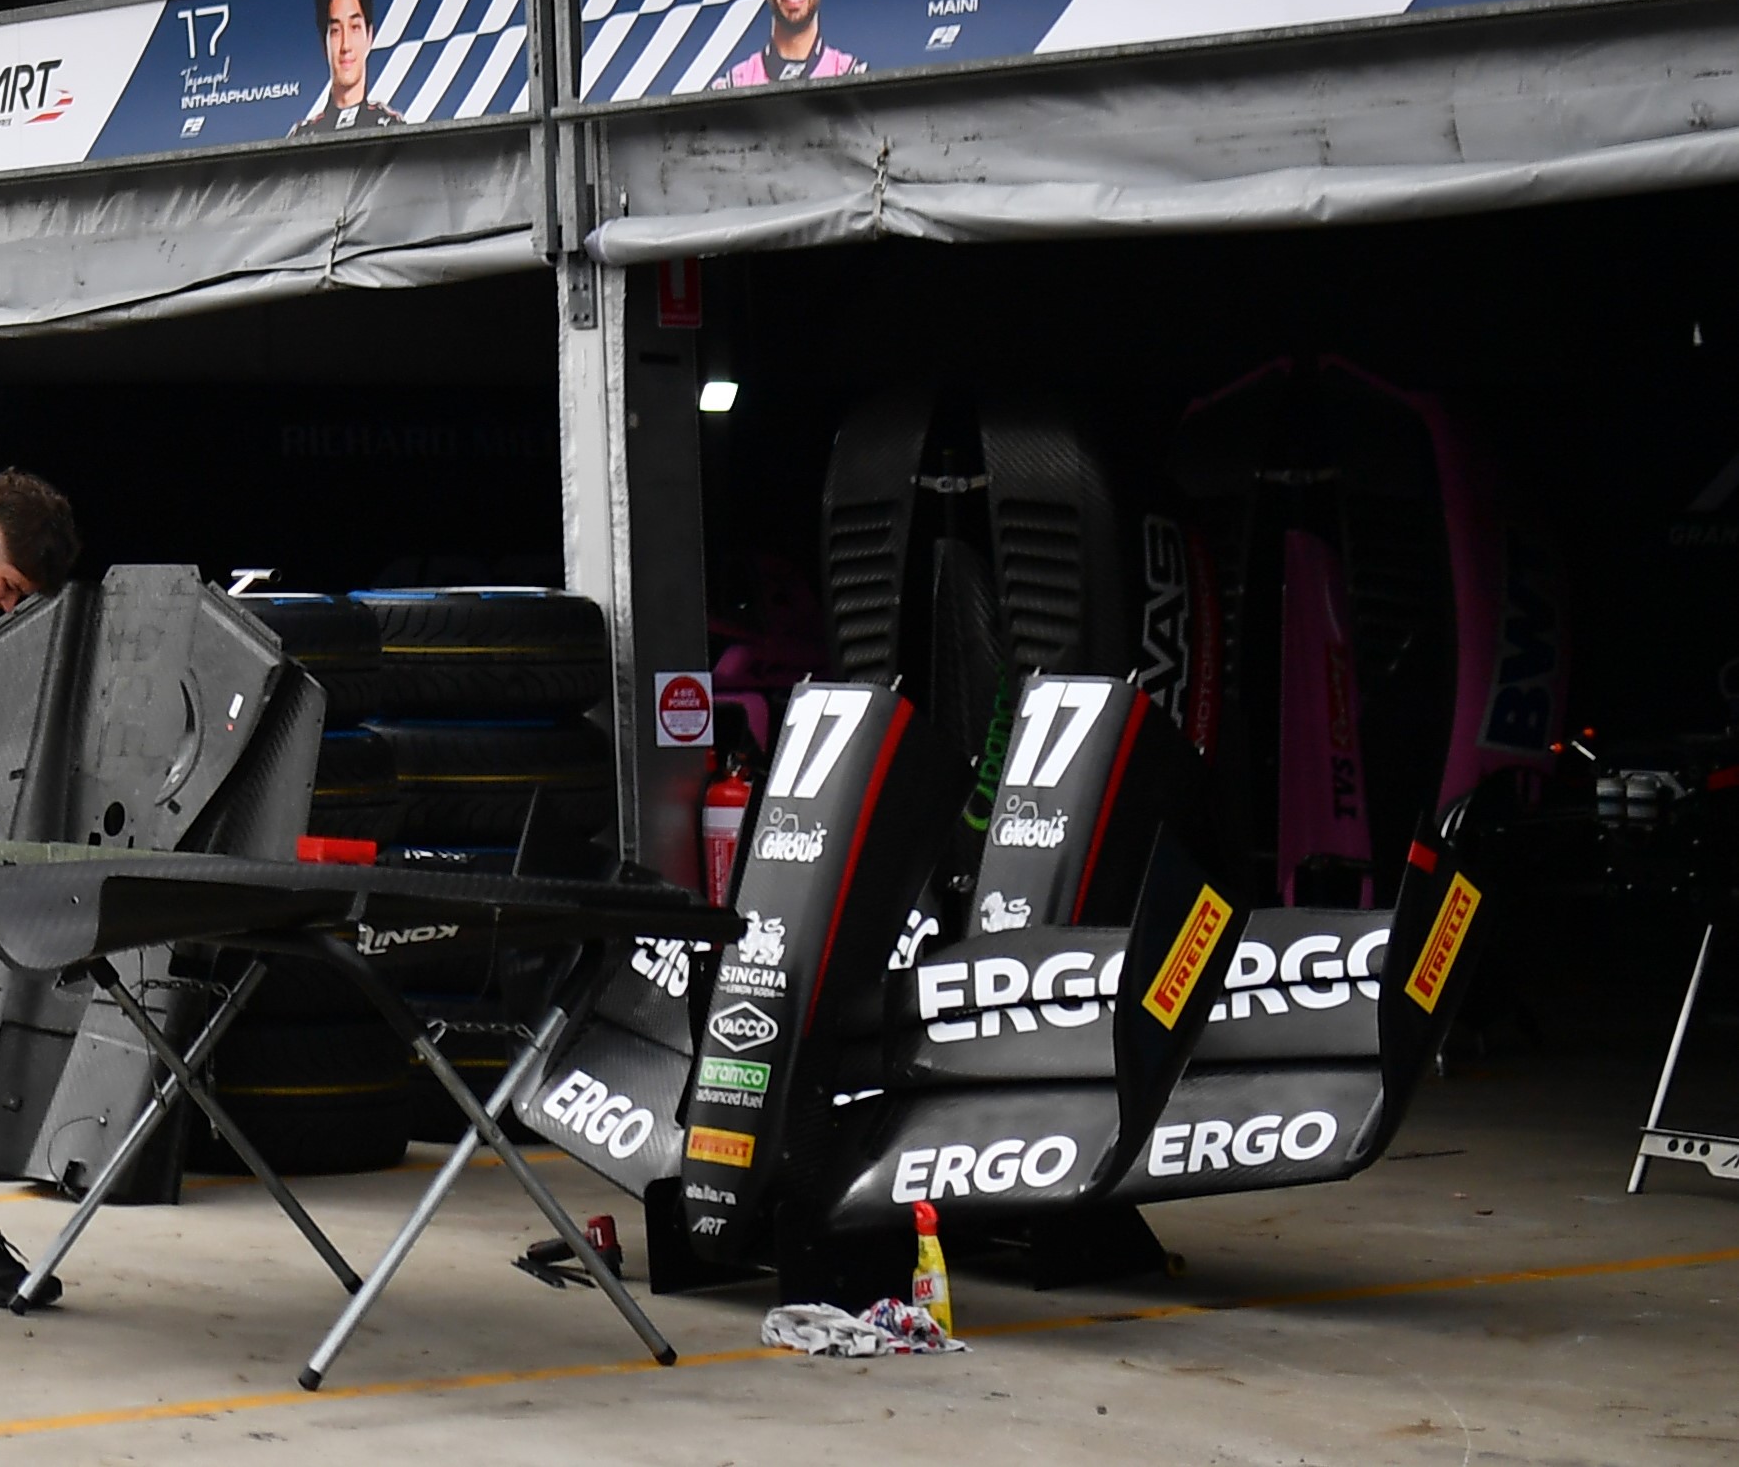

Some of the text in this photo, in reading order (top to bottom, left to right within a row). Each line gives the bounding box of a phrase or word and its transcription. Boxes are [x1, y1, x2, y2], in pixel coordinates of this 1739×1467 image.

[178, 2, 229, 59] 17
[181, 82, 299, 110] INTHRAPHUVASAK
[768, 689, 873, 799] 17
[1005, 681, 1113, 788] 17
[1153, 900, 1221, 1014] PIRELLI
[1414, 886, 1472, 998] PIRELLI
[721, 965, 787, 989] SINGHA
[718, 1018, 769, 1039] YACCO
[695, 1090, 739, 1107] advanced
[703, 1065, 764, 1088] aramco
[542, 1069, 654, 1160] ERGO
[1147, 1110, 1338, 1177] ERGO
[891, 1134, 1079, 1204] ERGO
[691, 1217, 728, 1236] ART
